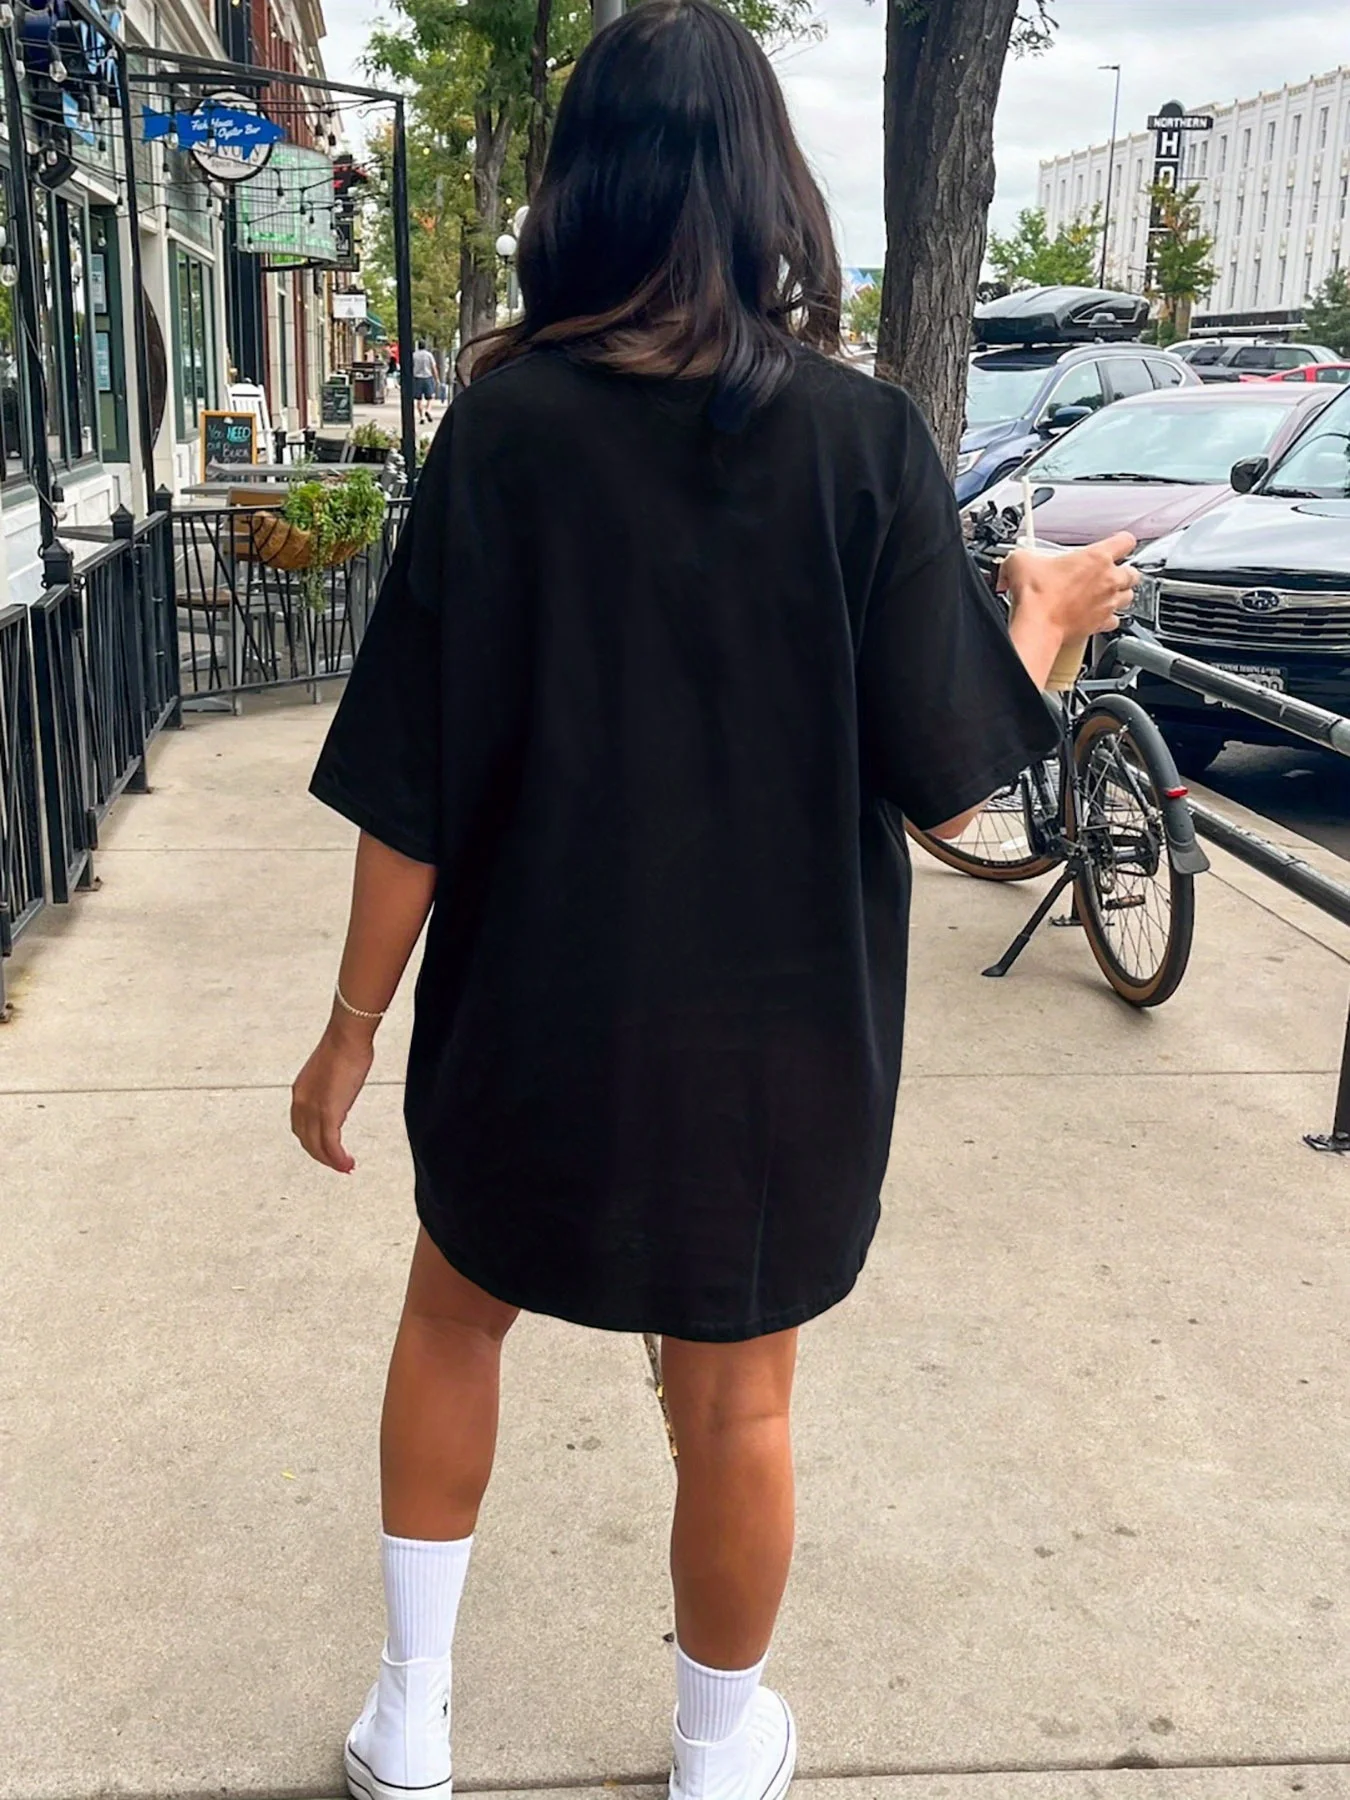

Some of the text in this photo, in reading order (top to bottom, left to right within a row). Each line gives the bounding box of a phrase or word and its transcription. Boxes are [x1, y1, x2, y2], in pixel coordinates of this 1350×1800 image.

[1153, 117, 1208, 128] NORTHERN
[217, 126, 243, 140] Oyster
[244, 123, 261, 135] Bar
[226, 425, 251, 440] NEED
